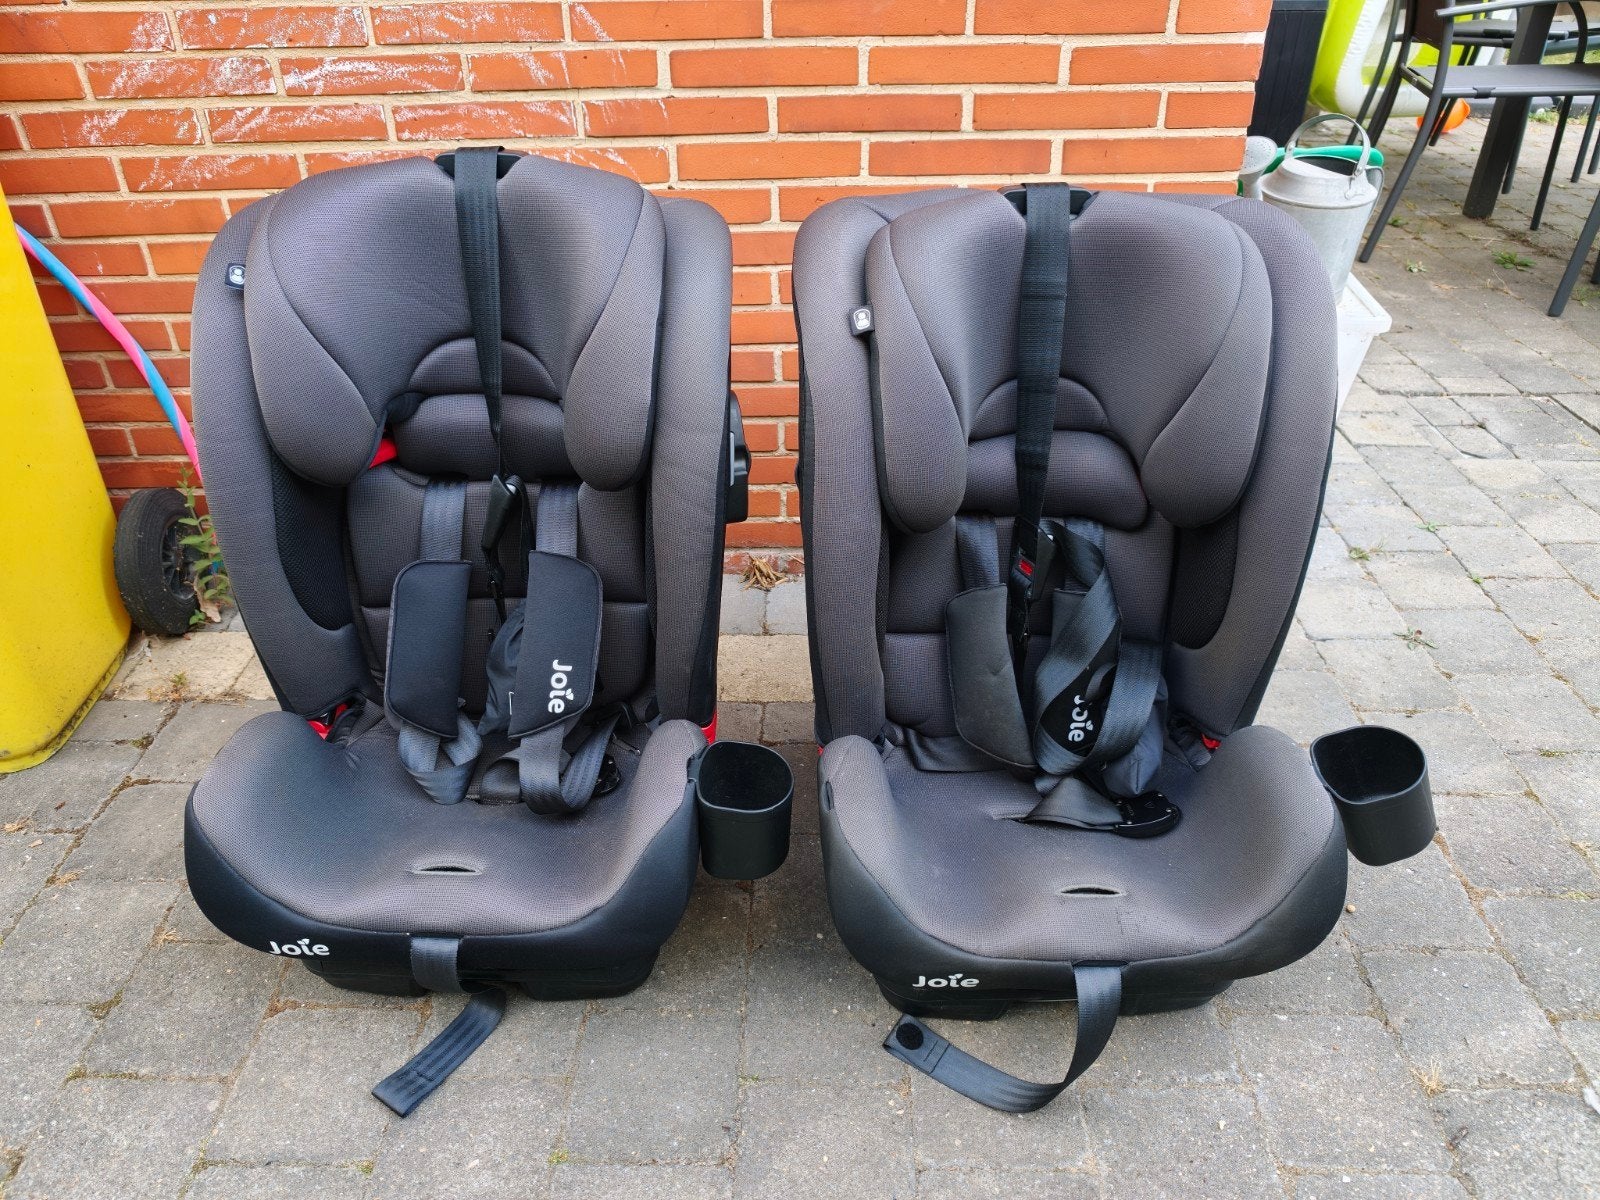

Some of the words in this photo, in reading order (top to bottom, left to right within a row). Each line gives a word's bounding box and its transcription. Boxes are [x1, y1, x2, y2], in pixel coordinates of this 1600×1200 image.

[547, 659, 574, 714] Joie
[268, 938, 330, 956] Joie
[912, 973, 980, 988] Joie
